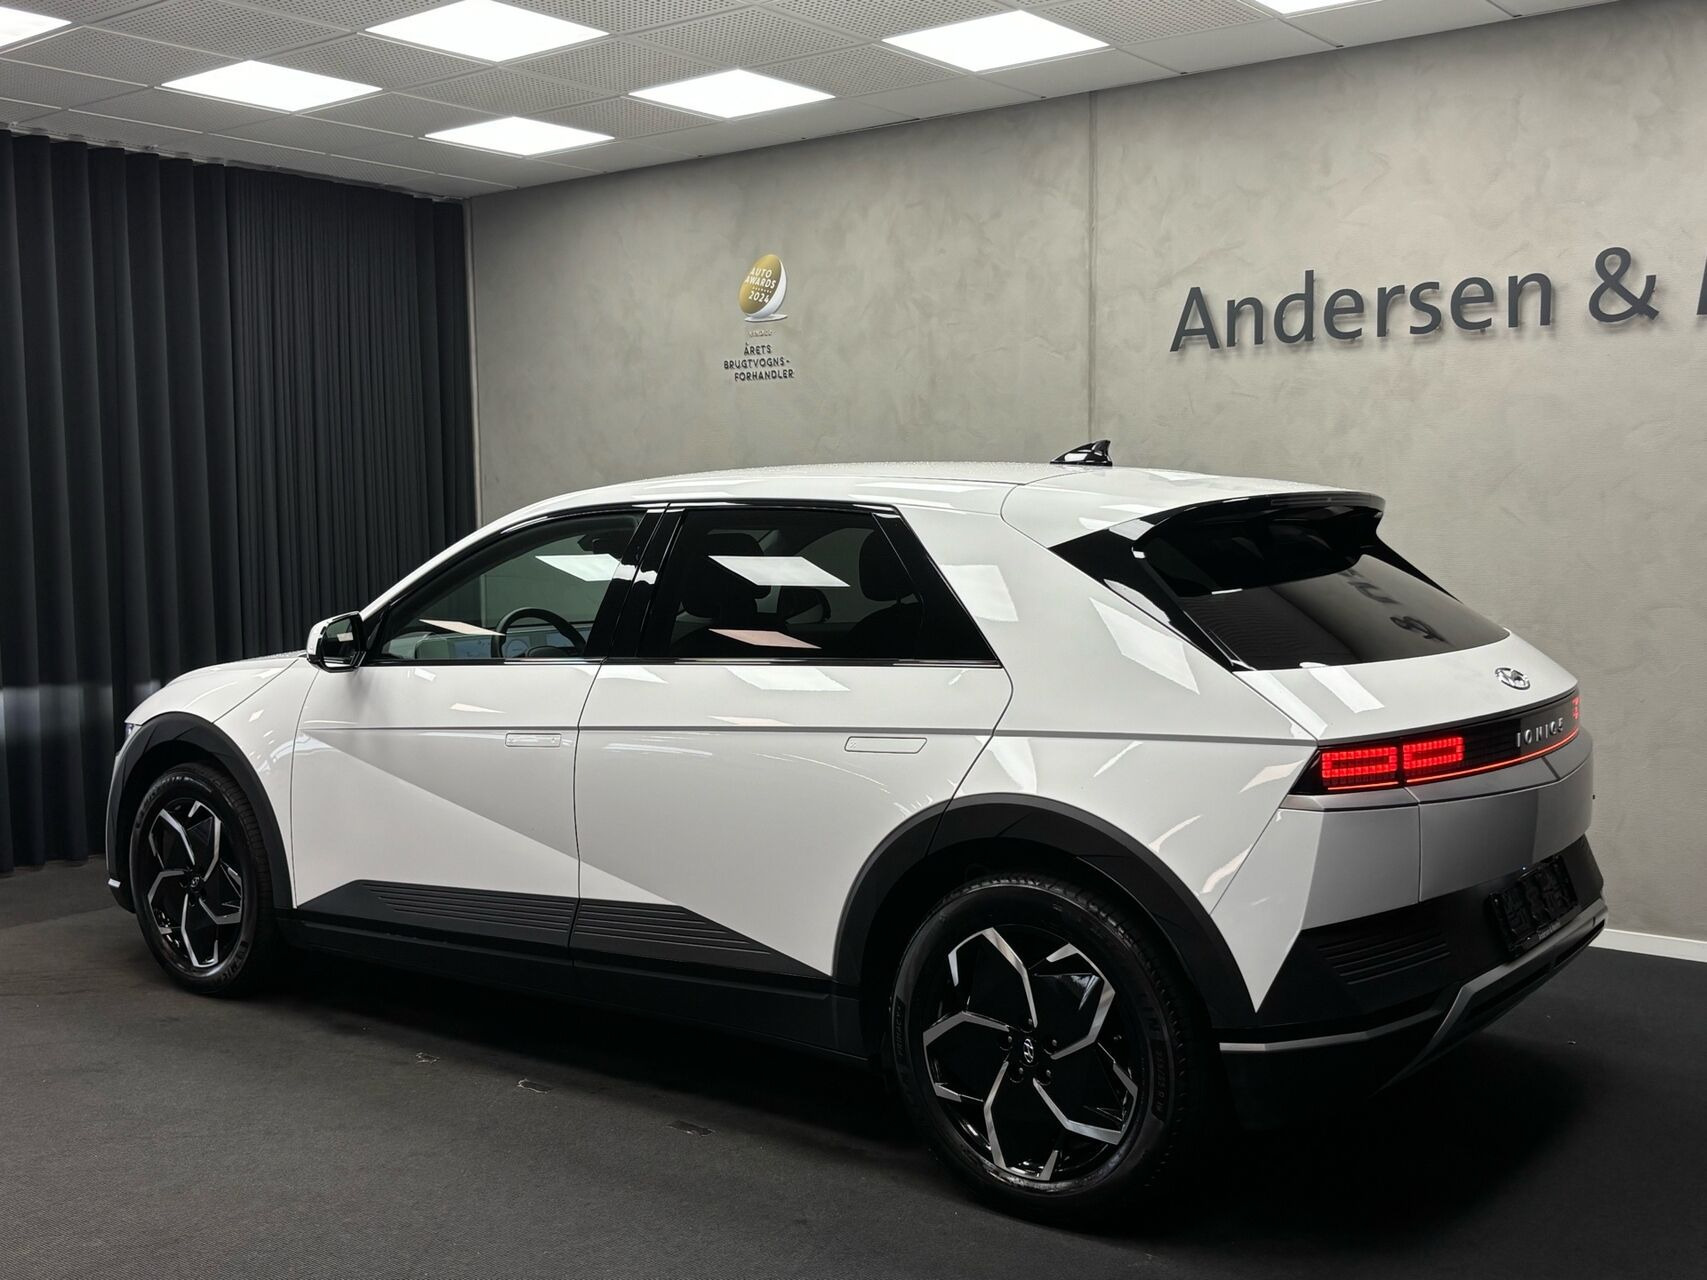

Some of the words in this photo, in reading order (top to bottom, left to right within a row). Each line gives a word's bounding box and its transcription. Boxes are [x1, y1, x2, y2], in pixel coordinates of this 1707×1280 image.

[750, 268, 772, 278] AUTO
[744, 276, 776, 289] AWARDS
[748, 290, 770, 303] 2024
[1170, 269, 1551, 352] Andersen
[1588, 246, 1659, 324] &
[743, 342, 772, 355] ÅRETS
[723, 357, 790, 370] BRUGTVOGNS-
[734, 369, 794, 381] FORHANDLER
